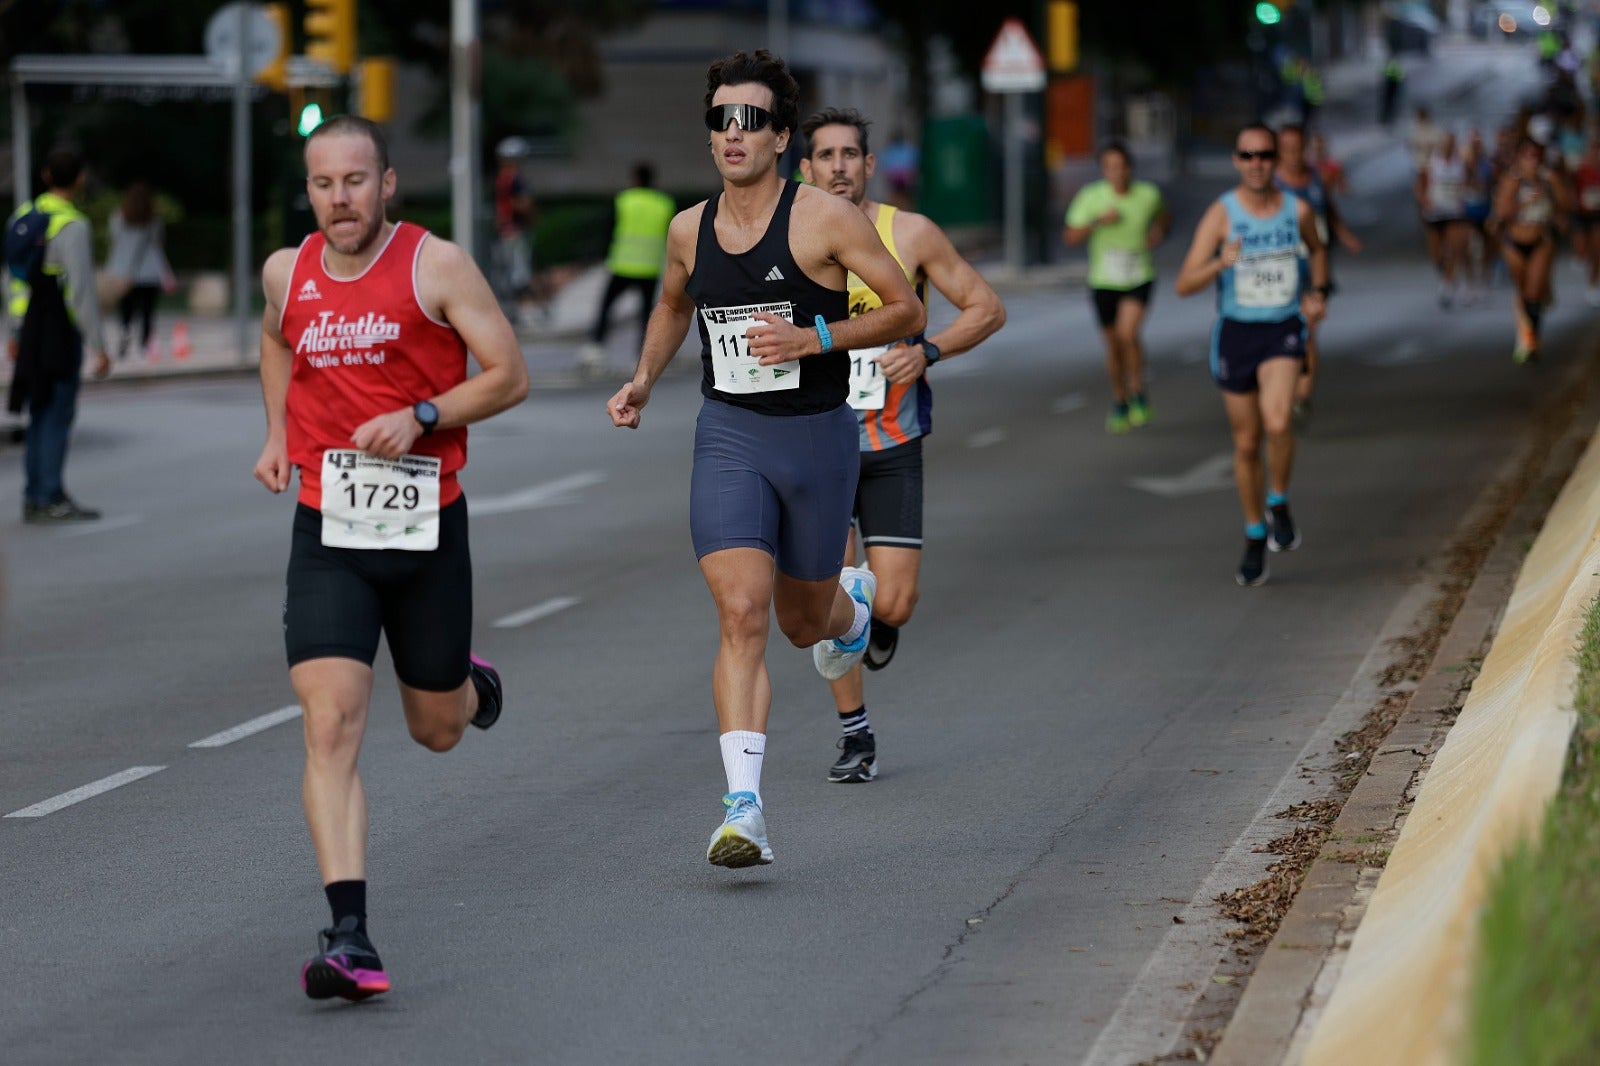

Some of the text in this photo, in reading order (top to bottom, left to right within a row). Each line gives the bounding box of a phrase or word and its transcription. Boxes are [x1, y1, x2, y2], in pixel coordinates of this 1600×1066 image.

[318, 310, 400, 338] Triatlón
[704, 309, 728, 324] 43
[306, 349, 386, 369] Valle del Sol
[328, 453, 357, 469] 43
[343, 483, 420, 510] 1729
